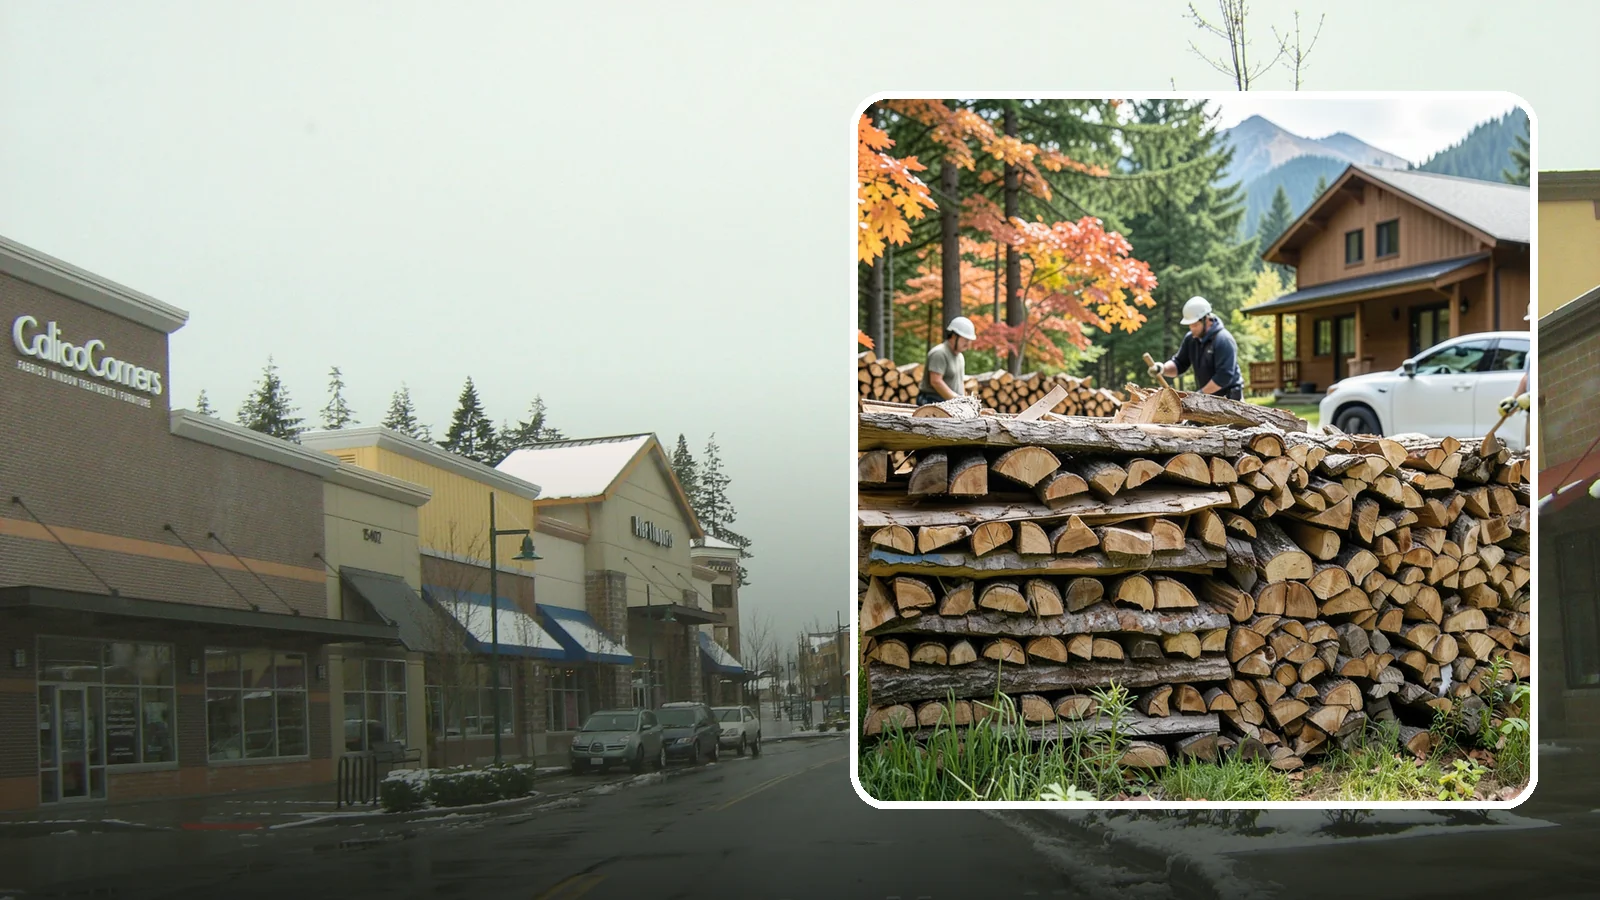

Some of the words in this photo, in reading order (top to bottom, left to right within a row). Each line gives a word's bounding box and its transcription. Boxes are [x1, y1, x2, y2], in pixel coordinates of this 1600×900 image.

[16, 360, 47, 377] FABRICS
[51, 370, 78, 386] WINDOW
[79, 378, 116, 398] TREATMENTS
[120, 391, 151, 408] FURNITURE
